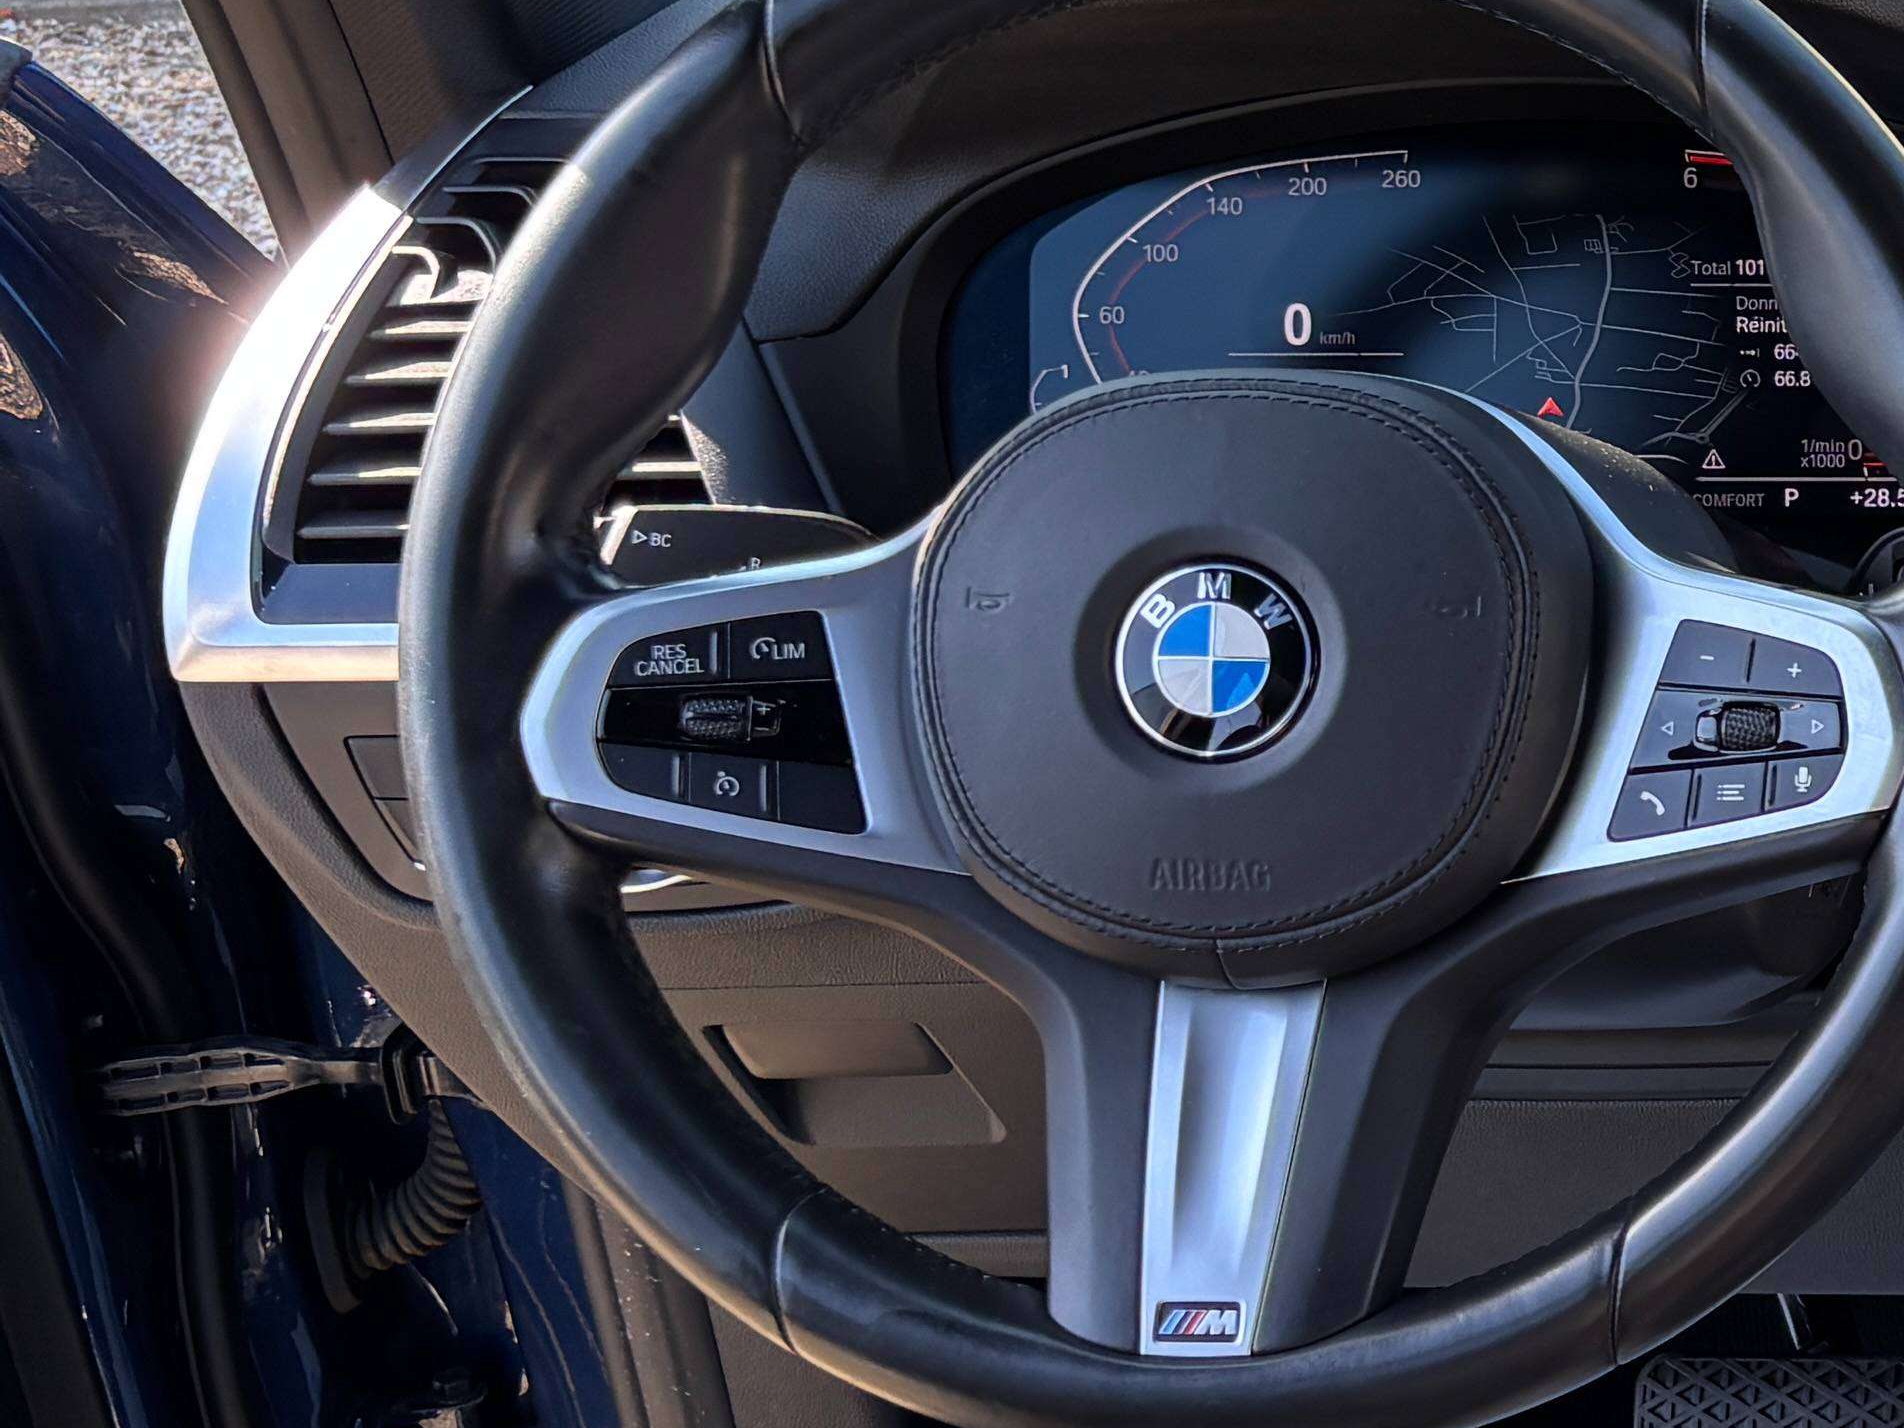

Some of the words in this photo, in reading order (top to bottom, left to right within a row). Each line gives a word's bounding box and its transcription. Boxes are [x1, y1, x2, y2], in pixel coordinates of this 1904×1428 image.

[1381, 170, 1422, 189] 260
[1682, 166, 1699, 189] 6
[1287, 178, 1328, 196] 200
[1205, 197, 1244, 216] 140
[1142, 244, 1179, 262] 100
[1690, 260, 1732, 276] Total
[1099, 306, 1126, 324] 60
[1283, 302, 1312, 346] 0
[1319, 331, 1356, 345] km/h
[1774, 370, 1811, 387] 66.8
[1800, 438, 1846, 453] 1/min
[1847, 438, 1863, 461] 0
[1800, 454, 1846, 469] x1000
[1784, 488, 1800, 507] P
[649, 533, 672, 548] BC
[1140, 571, 1294, 631] BMW
[651, 643, 688, 660] RES
[772, 642, 806, 660] LIM
[634, 658, 705, 676] CANCEL
[1150, 857, 1273, 892] AIRBAG
